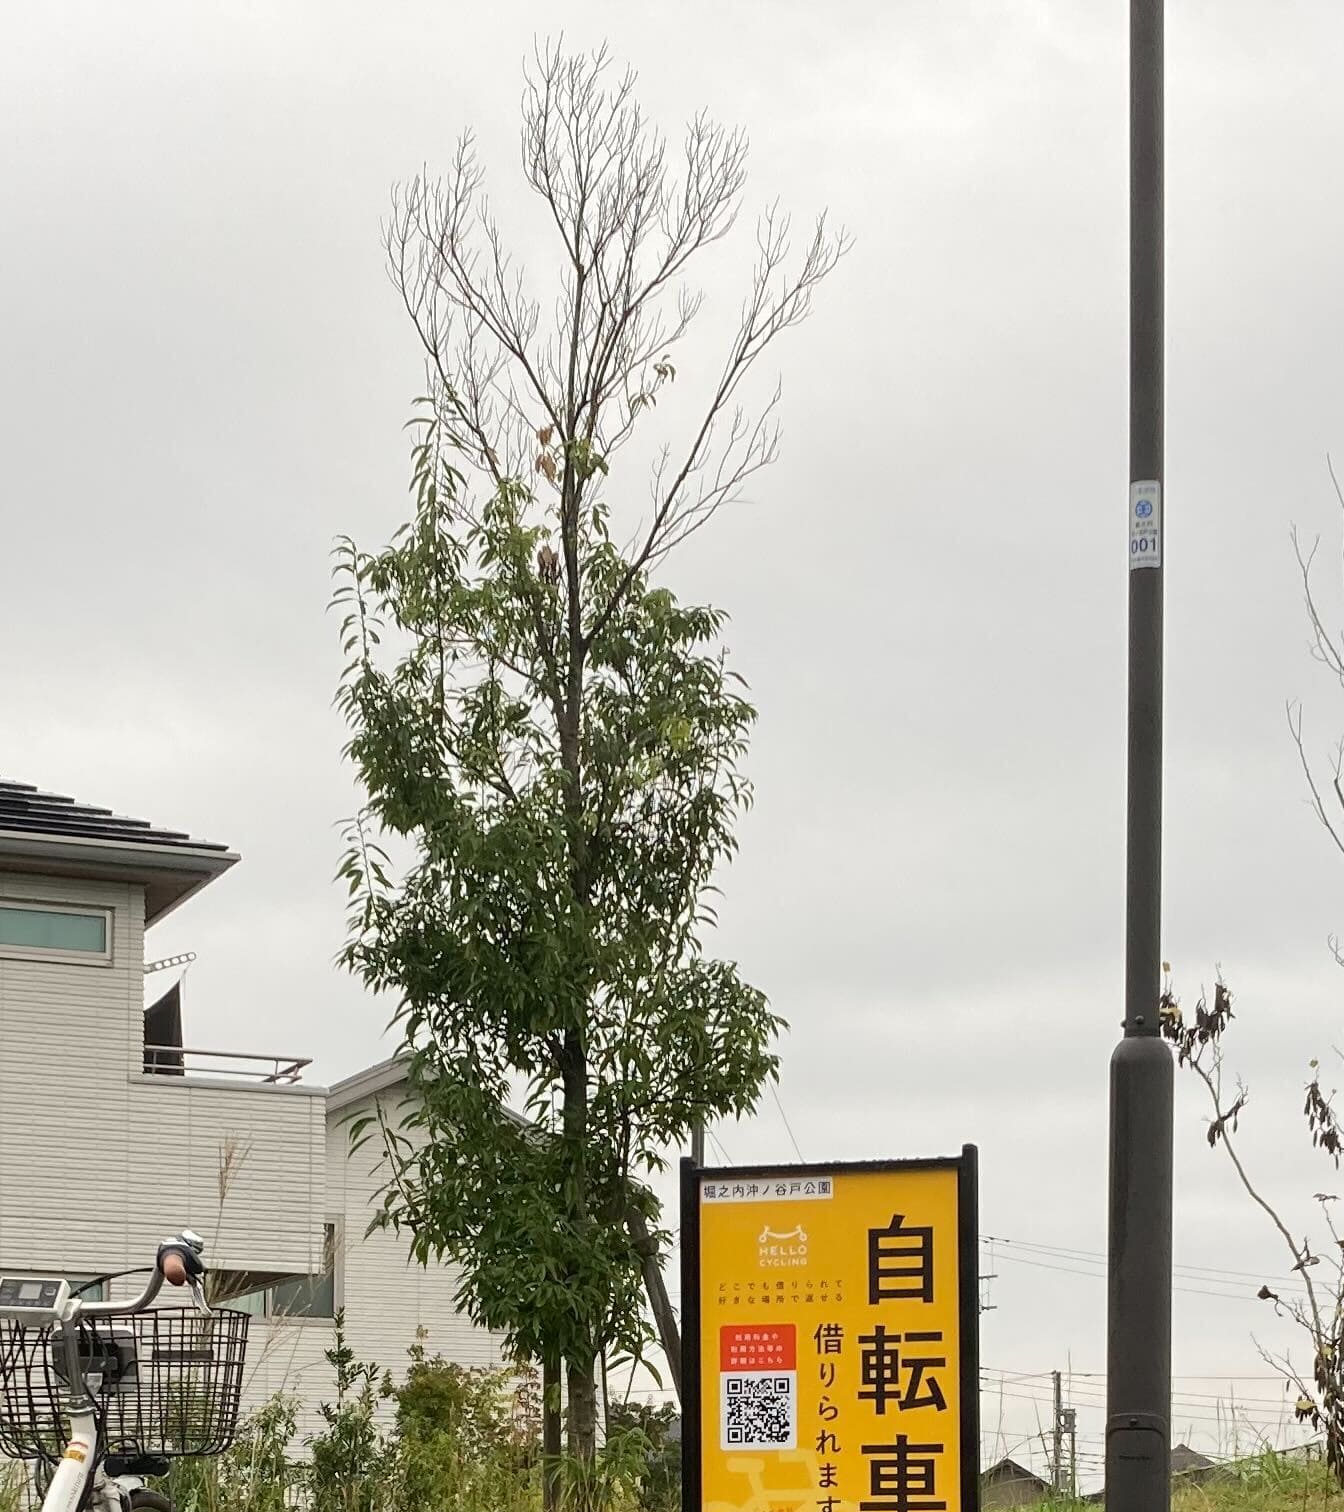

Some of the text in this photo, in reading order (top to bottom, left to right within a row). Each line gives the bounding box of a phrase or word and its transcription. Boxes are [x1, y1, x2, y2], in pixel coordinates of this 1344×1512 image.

[1131, 537, 1156, 554] 001
[759, 1245, 808, 1256] HELLO
[759, 1257, 808, 1267] CYCLING
